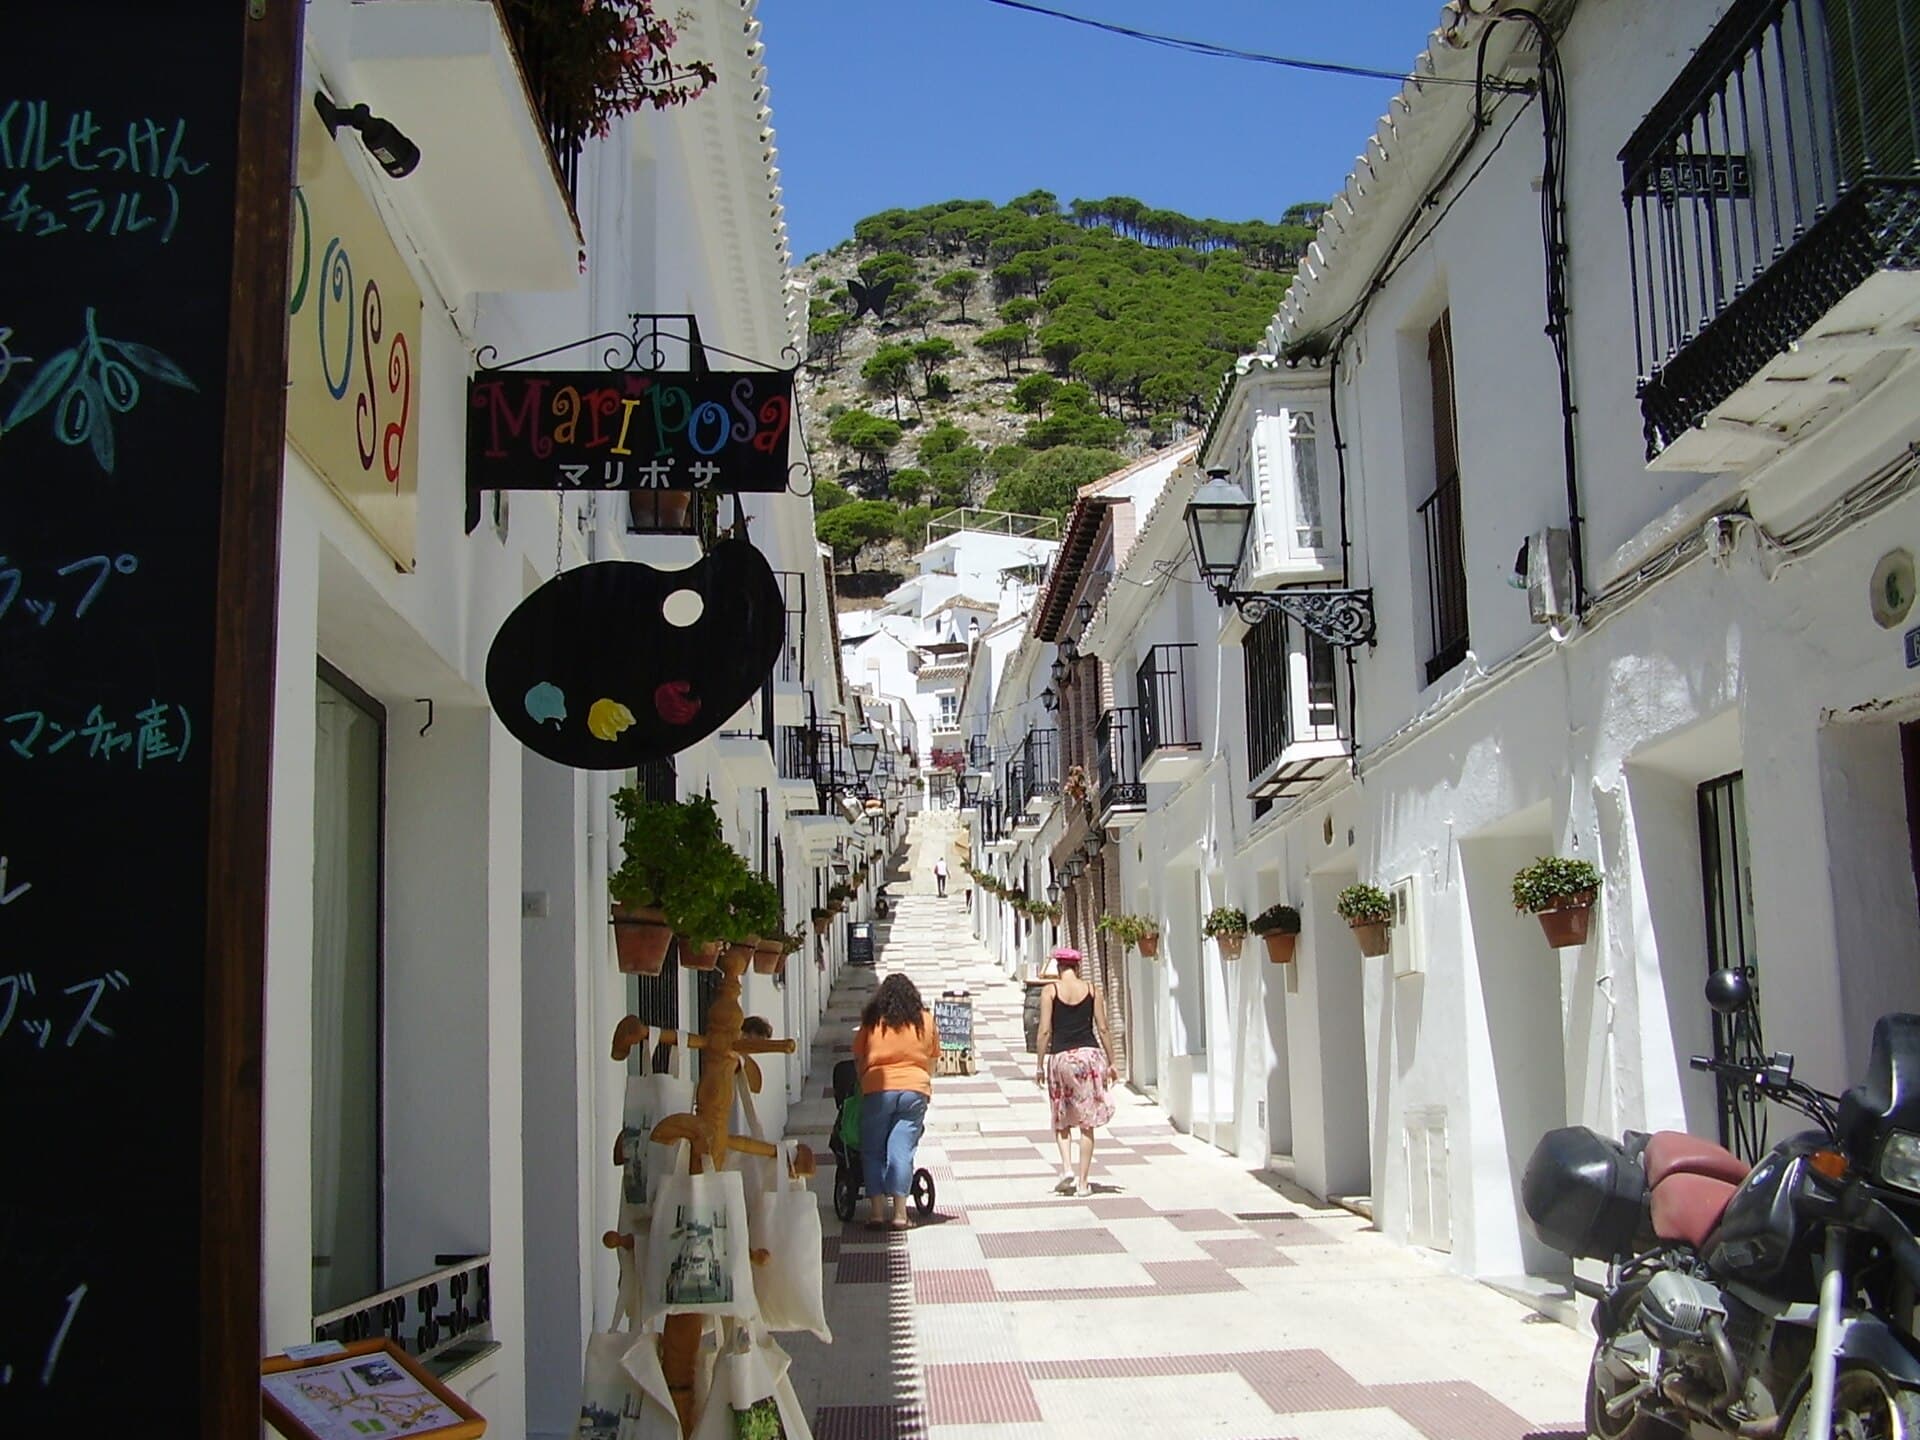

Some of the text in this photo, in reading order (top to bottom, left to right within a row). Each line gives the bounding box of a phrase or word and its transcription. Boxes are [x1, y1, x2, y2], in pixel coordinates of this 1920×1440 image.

[0, 184, 178, 242] チュラル)
[558, 458, 721, 489] マリポサ
